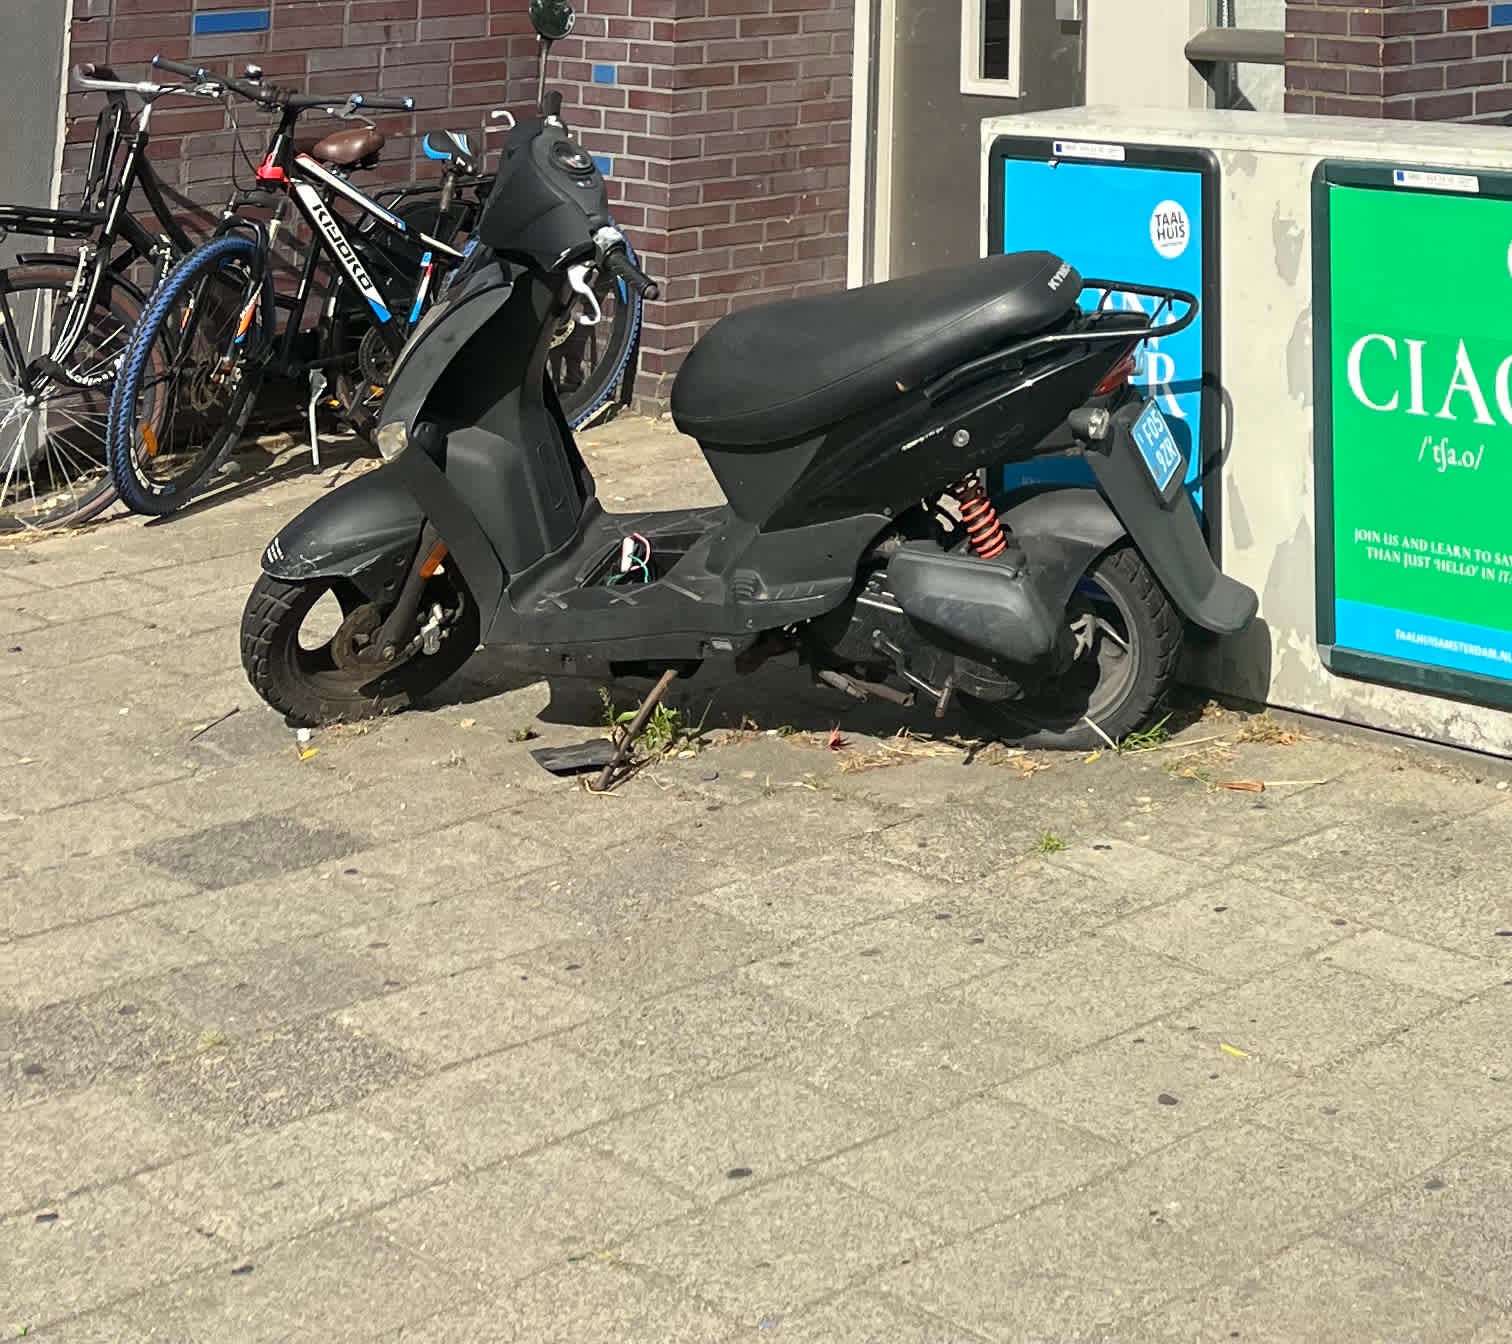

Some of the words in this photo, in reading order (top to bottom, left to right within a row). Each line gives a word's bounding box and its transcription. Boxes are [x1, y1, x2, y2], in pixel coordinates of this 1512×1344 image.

[1155, 211, 1185, 228] TAAL
[1156, 224, 1186, 241] HUIS
[1354, 528, 1381, 544] JOIN
[1383, 532, 1399, 546] US
[1401, 535, 1428, 553] AND
[1430, 541, 1471, 560] LEARN
[1474, 548, 1492, 563] TO
[1366, 546, 1401, 563] THAN
[1404, 552, 1431, 568] JUST
[1481, 567, 1496, 580] IN
